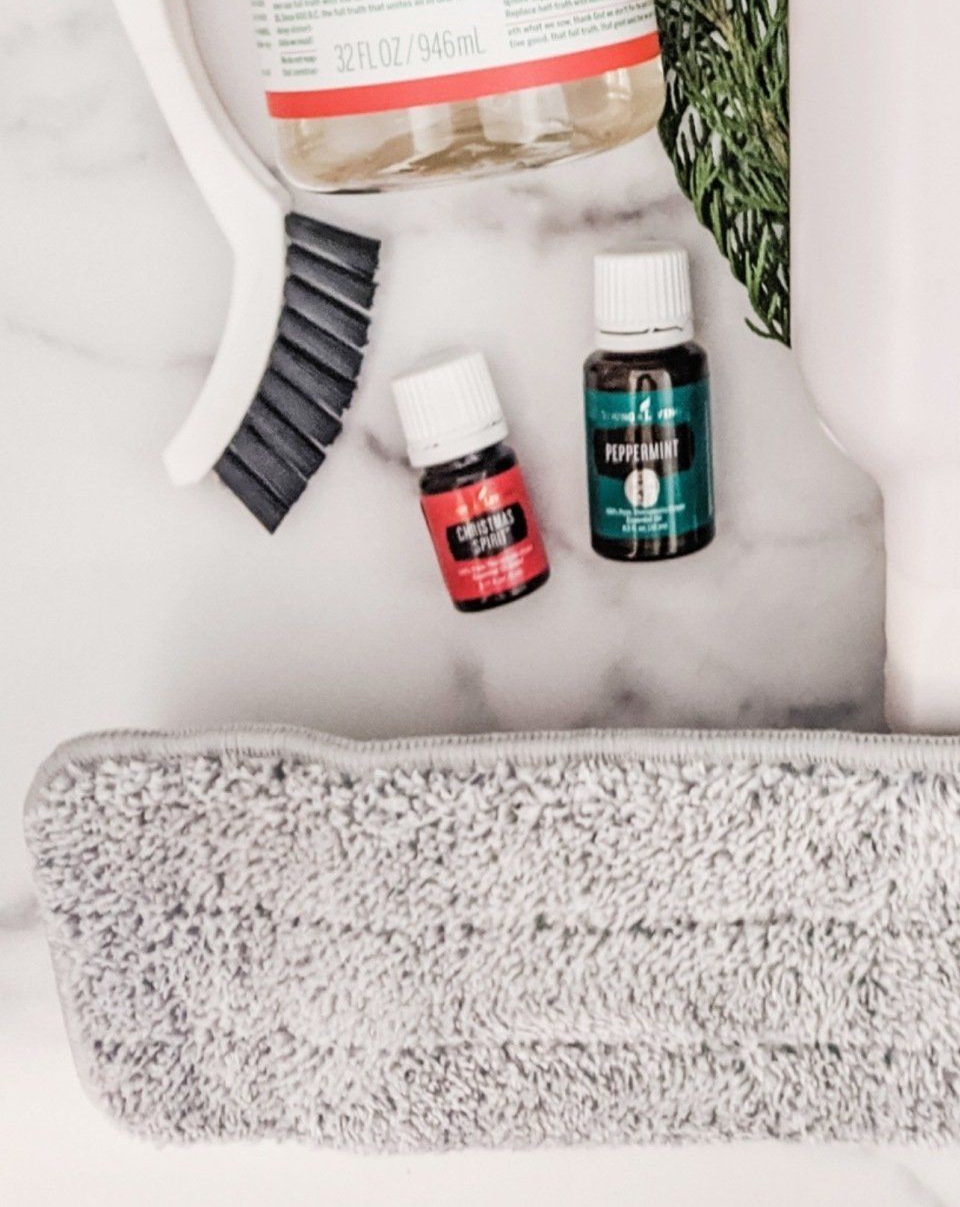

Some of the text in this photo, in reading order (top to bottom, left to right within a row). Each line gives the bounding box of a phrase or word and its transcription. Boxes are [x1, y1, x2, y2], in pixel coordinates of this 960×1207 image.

[334, 42, 355, 73] 32
[357, 40, 378, 70] FL
[379, 36, 403, 67] OZ
[418, 25, 488, 63] 946mL
[605, 439, 679, 464] PEPPERMINT
[456, 508, 515, 543] CHRISTMAS
